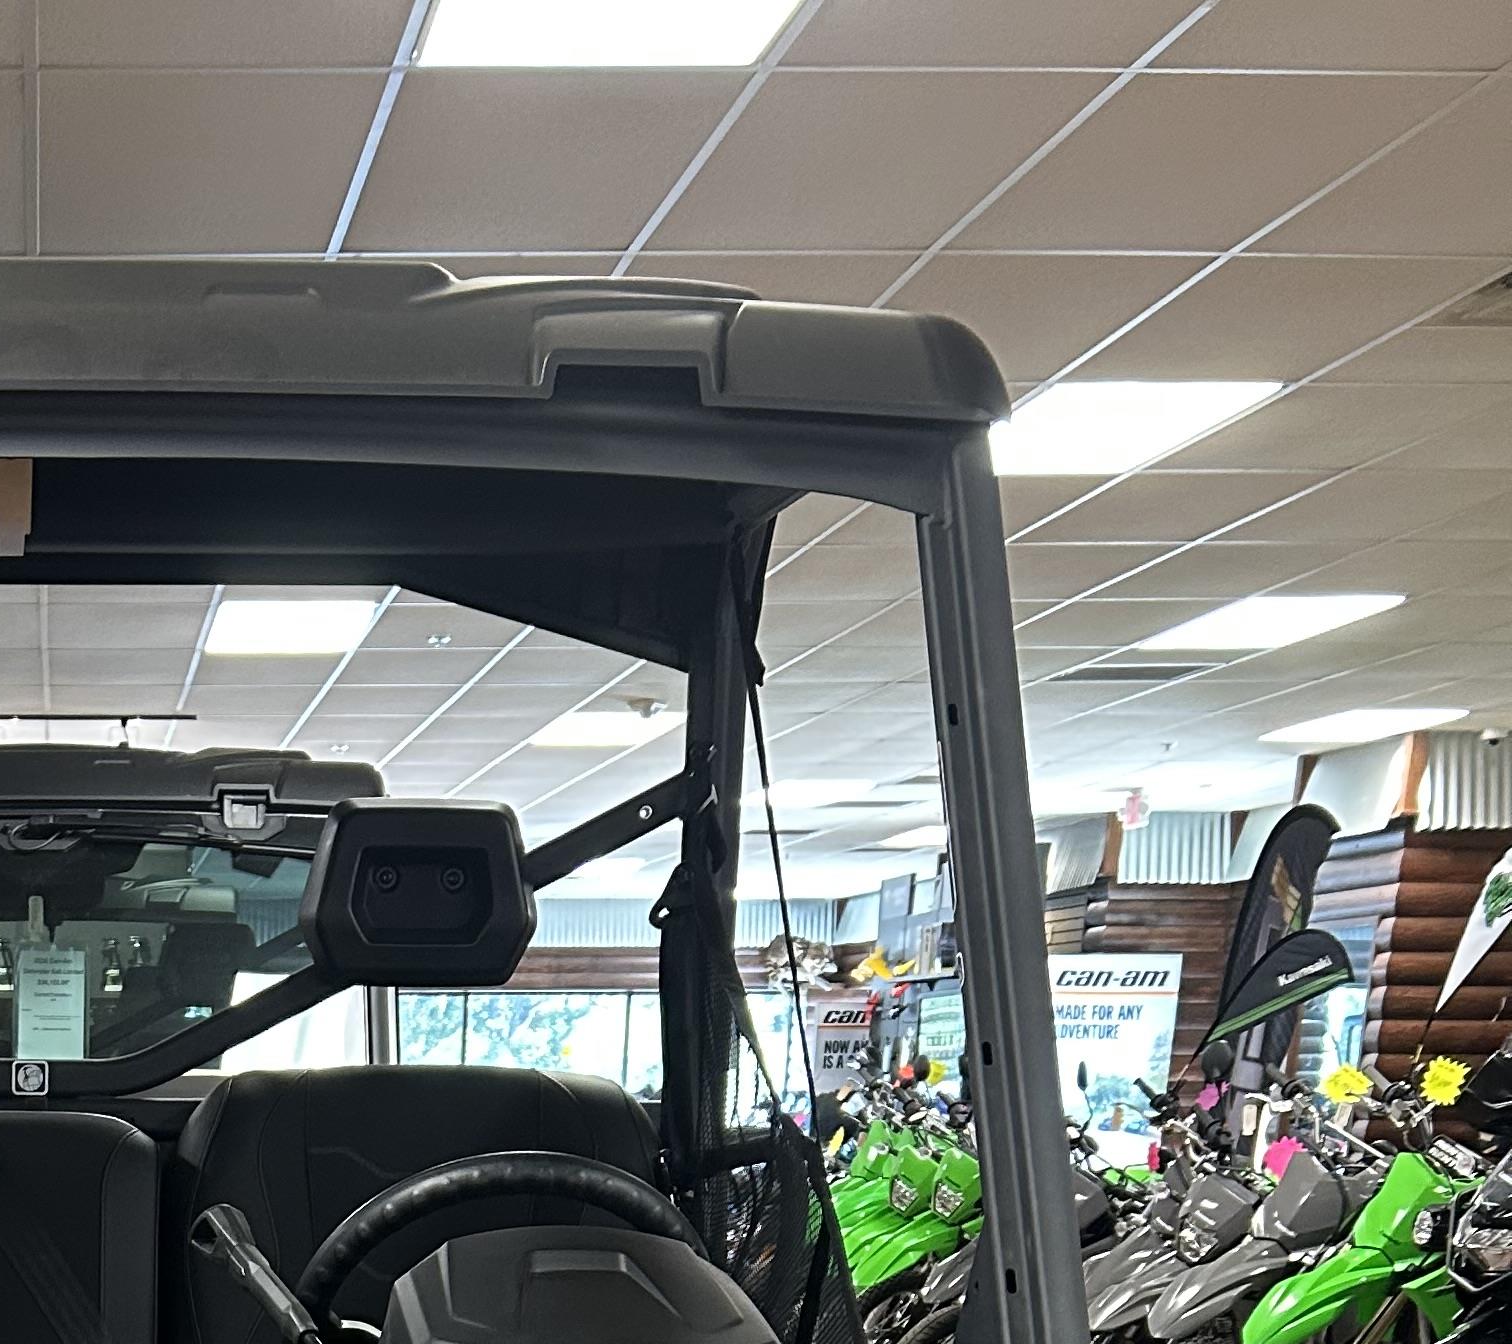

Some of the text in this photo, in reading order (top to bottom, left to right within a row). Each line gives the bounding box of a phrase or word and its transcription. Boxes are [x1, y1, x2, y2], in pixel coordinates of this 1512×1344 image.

[1056, 970, 1171, 987] can-am
[823, 1010, 866, 1024] can
[1092, 1005, 1114, 1020] FOR
[1117, 1005, 1144, 1020] ANY
[1056, 1024, 1120, 1039] DVENTURE
[824, 1040, 850, 1054] NOW
[823, 1055, 844, 1069] IS A
